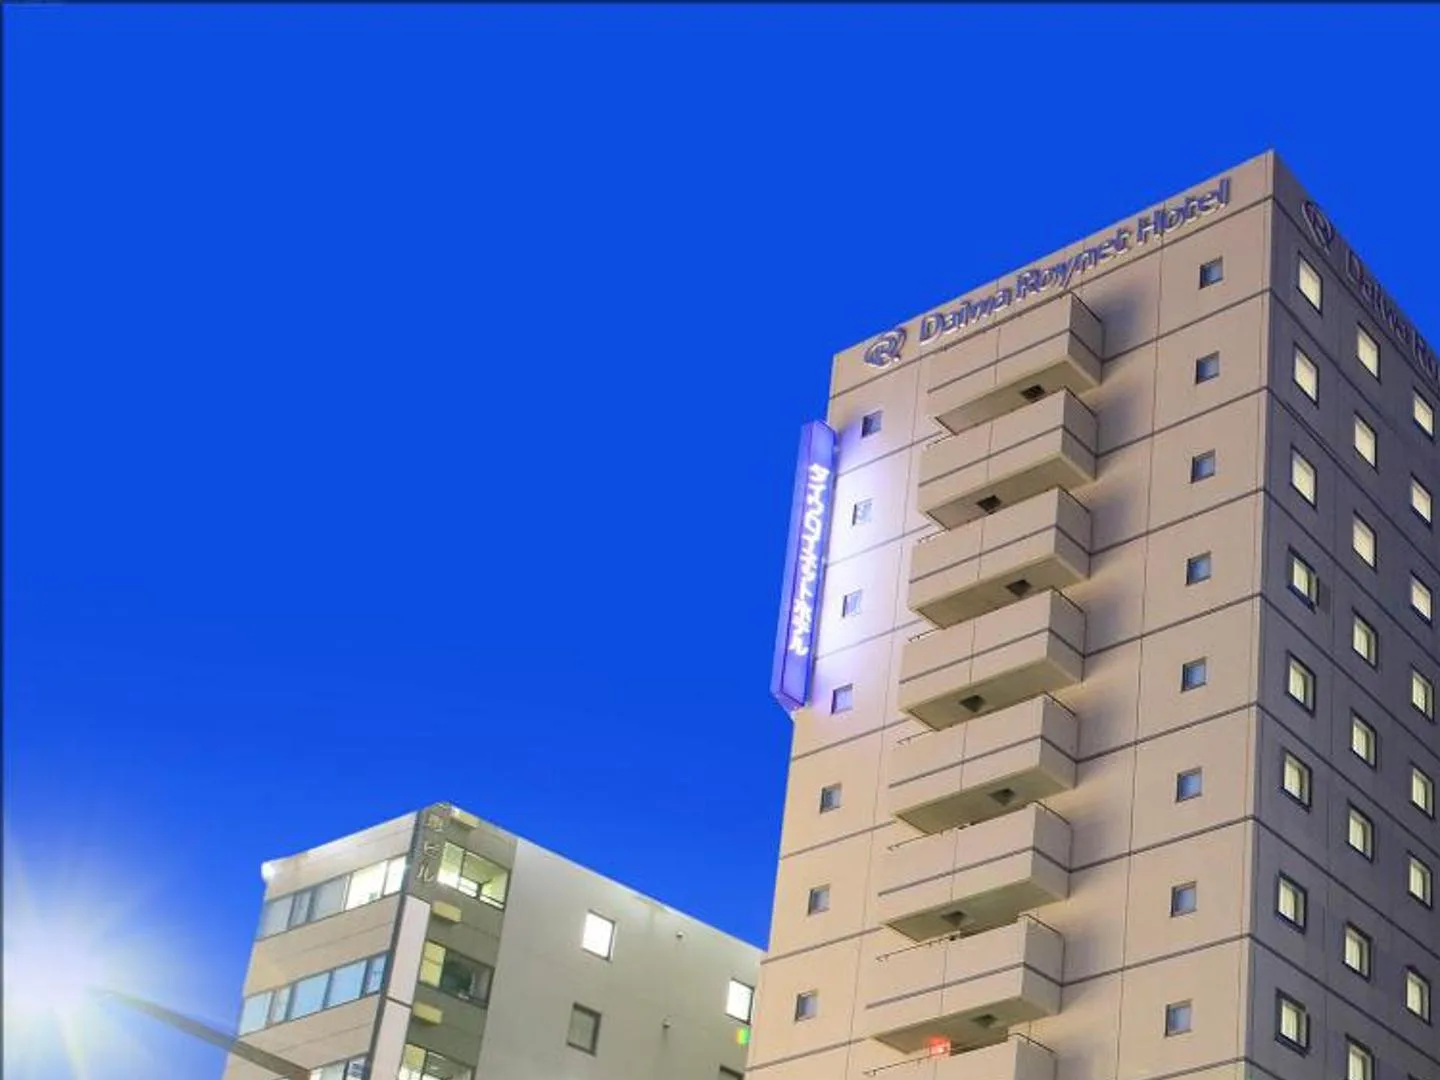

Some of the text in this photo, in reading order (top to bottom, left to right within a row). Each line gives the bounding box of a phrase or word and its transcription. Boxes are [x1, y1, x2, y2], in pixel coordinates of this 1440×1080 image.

[919, 287, 1013, 345] Daiwa
[1014, 228, 1131, 302] Roynet
[1136, 177, 1231, 246] Hotel
